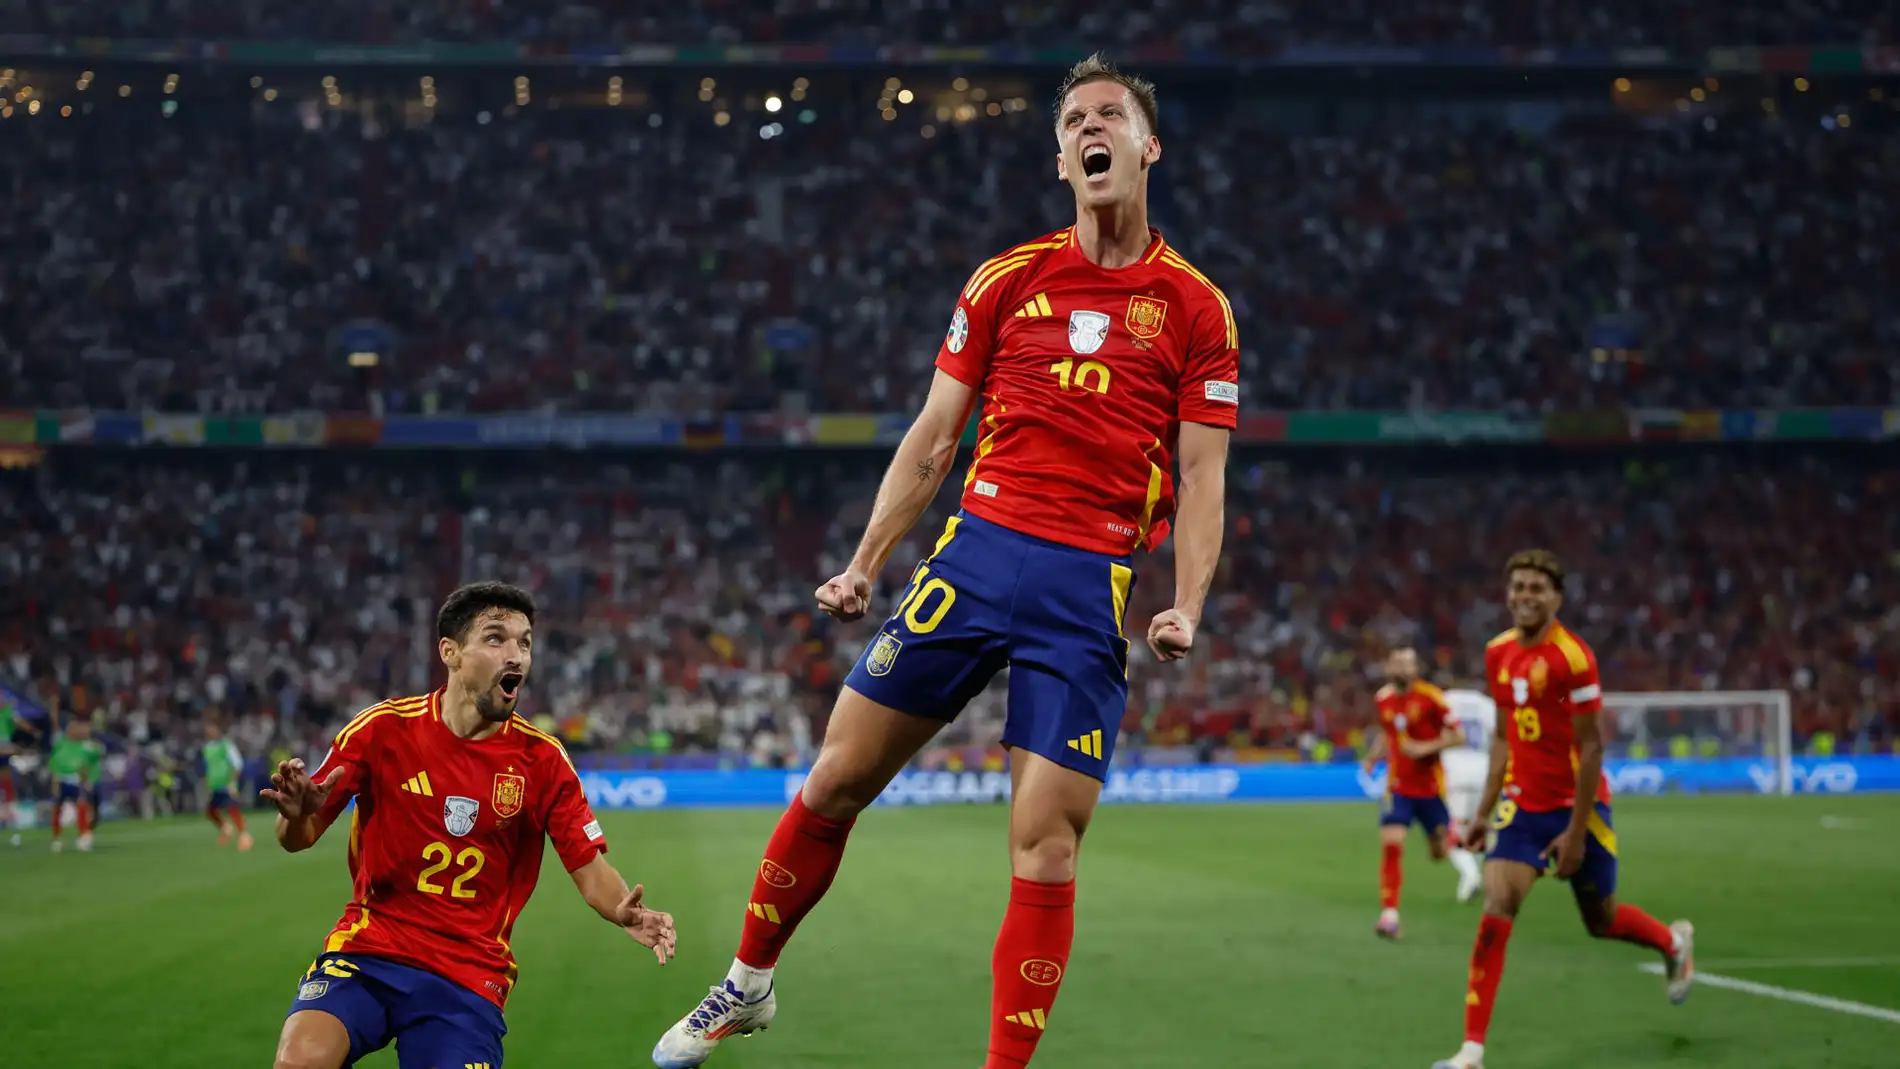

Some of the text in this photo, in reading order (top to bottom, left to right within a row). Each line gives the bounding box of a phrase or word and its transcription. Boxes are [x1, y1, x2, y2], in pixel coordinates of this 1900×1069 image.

[1049, 356, 1110, 394] 10
[892, 565, 956, 634] 10
[1513, 706, 1541, 742] 19
[1492, 799, 1518, 830] 9
[417, 841, 486, 898] 22
